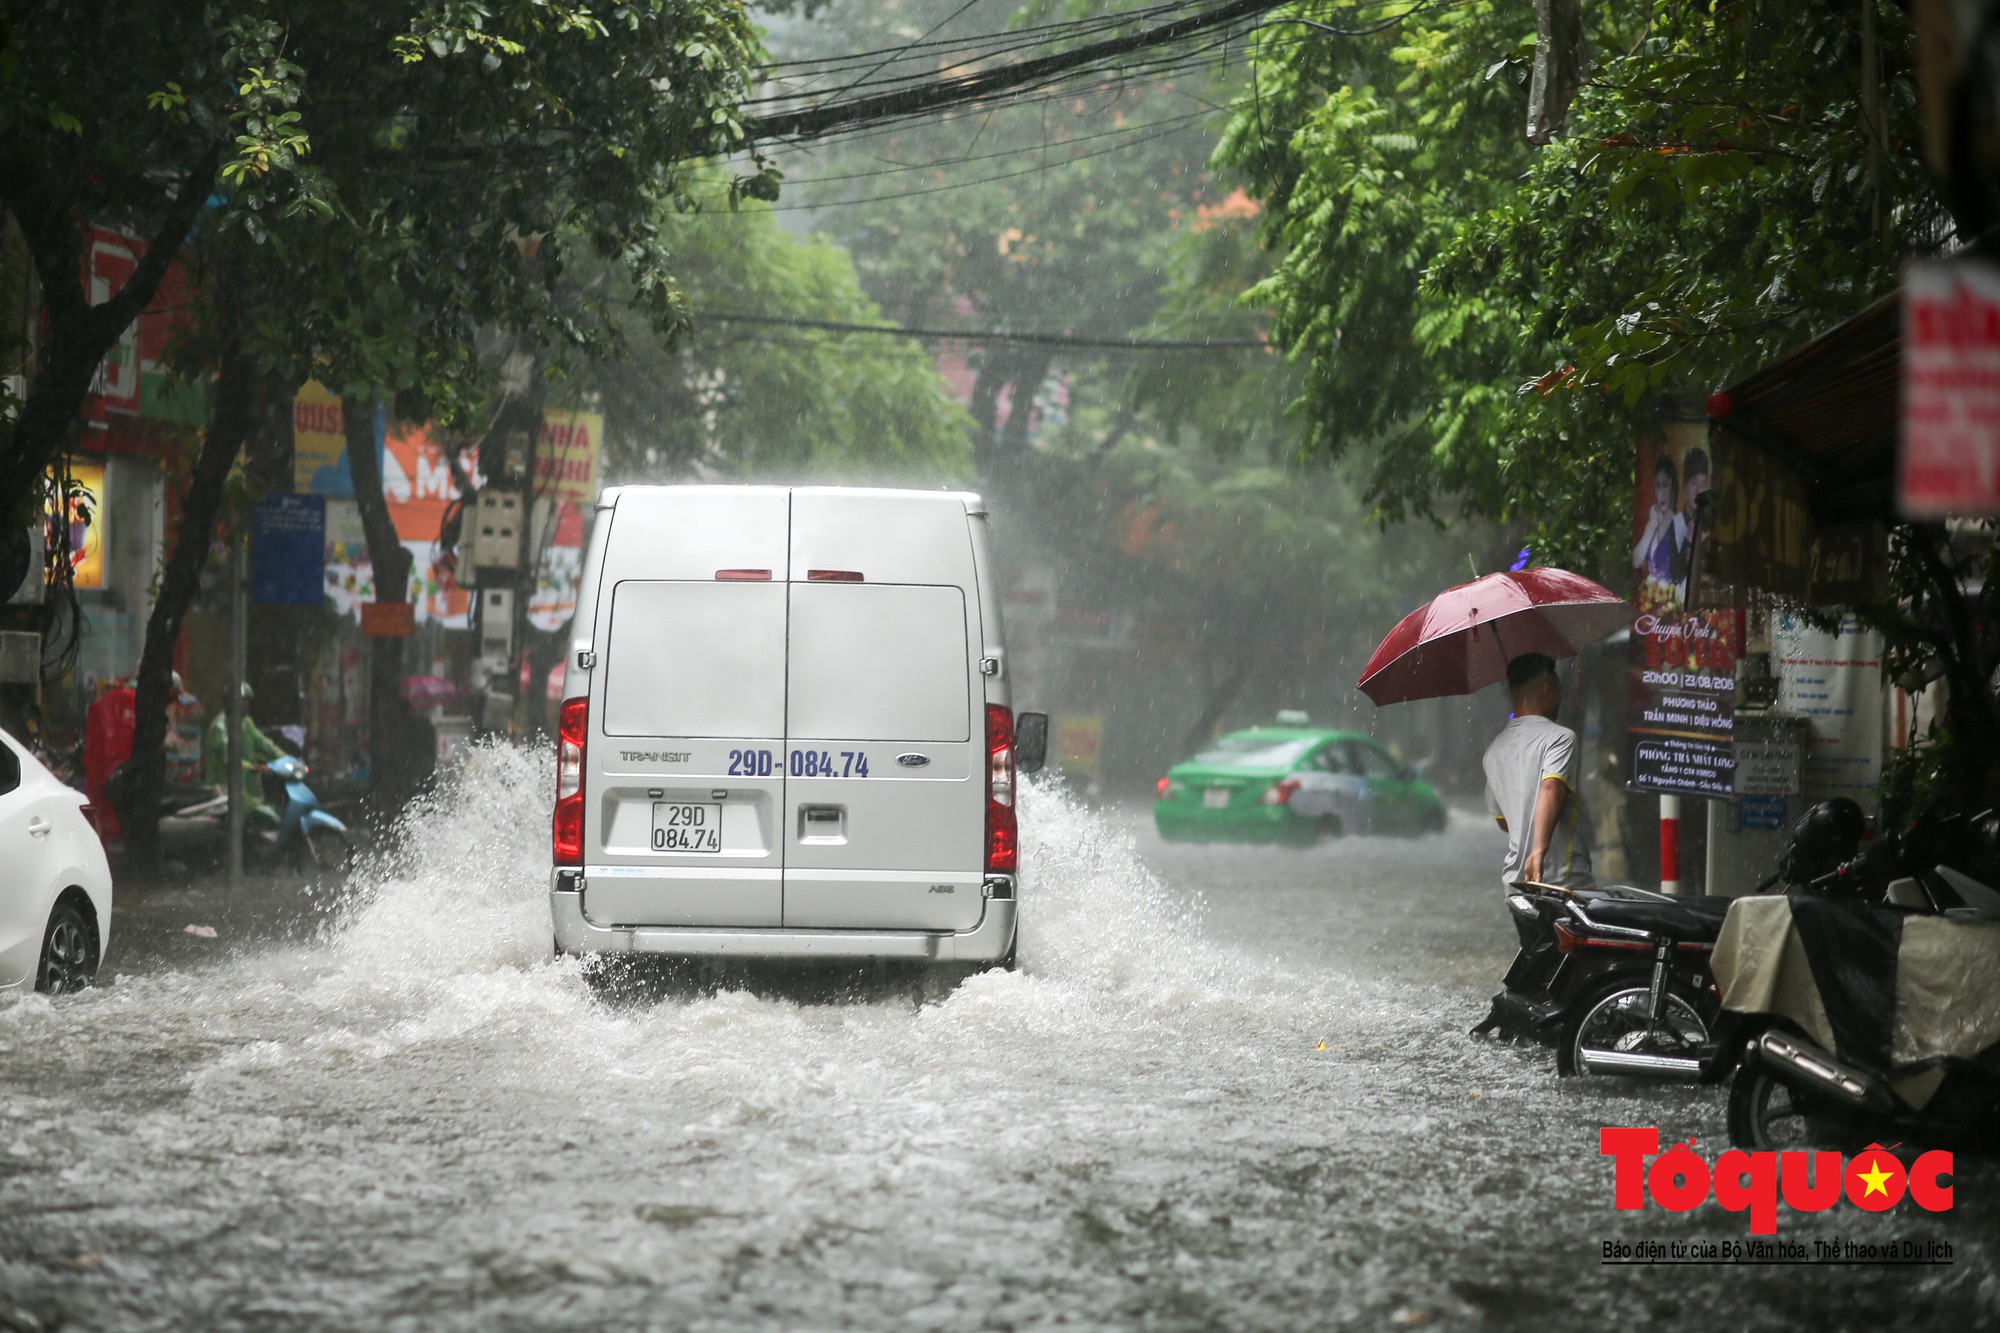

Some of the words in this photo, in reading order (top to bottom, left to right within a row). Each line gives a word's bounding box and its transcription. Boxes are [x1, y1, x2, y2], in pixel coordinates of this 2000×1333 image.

[1642, 671, 1678, 685] 20h00
[1666, 713, 1689, 725] MINH
[620, 750, 692, 763] TRANSIT
[790, 749, 869, 778] 084.74
[668, 805, 705, 827] 29D
[653, 828, 718, 850] 084.74
